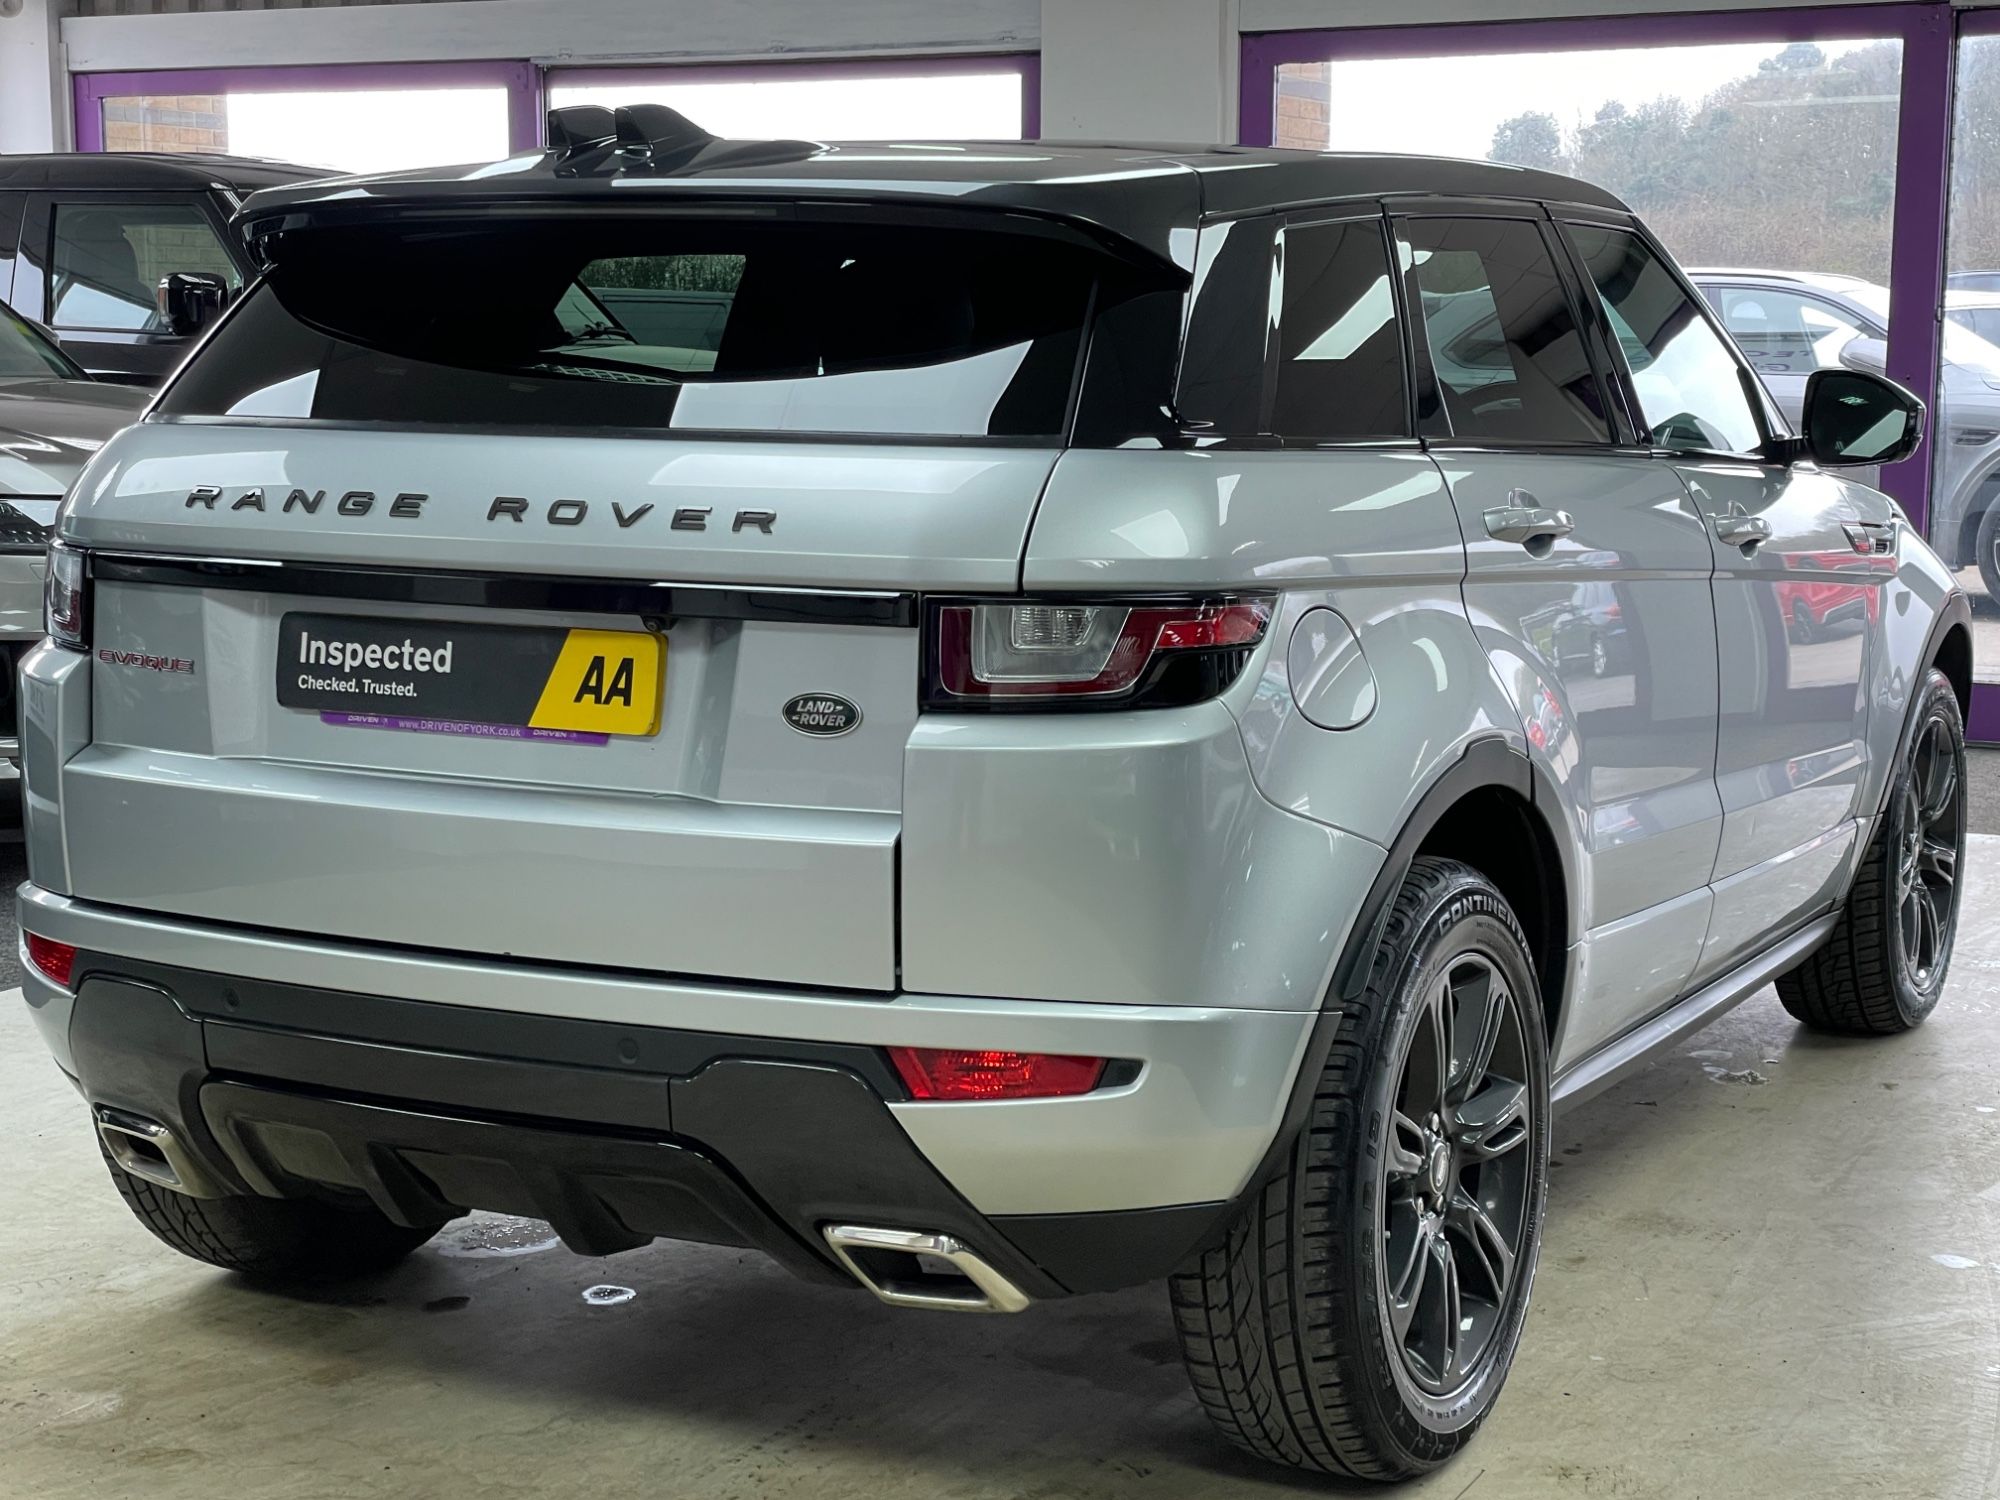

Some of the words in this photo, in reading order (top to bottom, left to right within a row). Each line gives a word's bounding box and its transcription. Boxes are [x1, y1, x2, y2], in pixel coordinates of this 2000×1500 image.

[185, 485, 429, 518] RANGE
[487, 496, 777, 534] ROVER
[99, 649, 195, 674] EVOQUE
[300, 631, 453, 674] Inspected
[298, 674, 359, 693] Checked.
[362, 679, 418, 697] Trusted.
[573, 656, 635, 707] AA
[796, 700, 835, 713] LAND
[347, 715, 379, 724] DRIVEN
[398, 720, 521, 737] www.DRIVENOFYORK.co.uk
[533, 729, 568, 738] DRIVEN
[799, 713, 846, 727] ROVER
